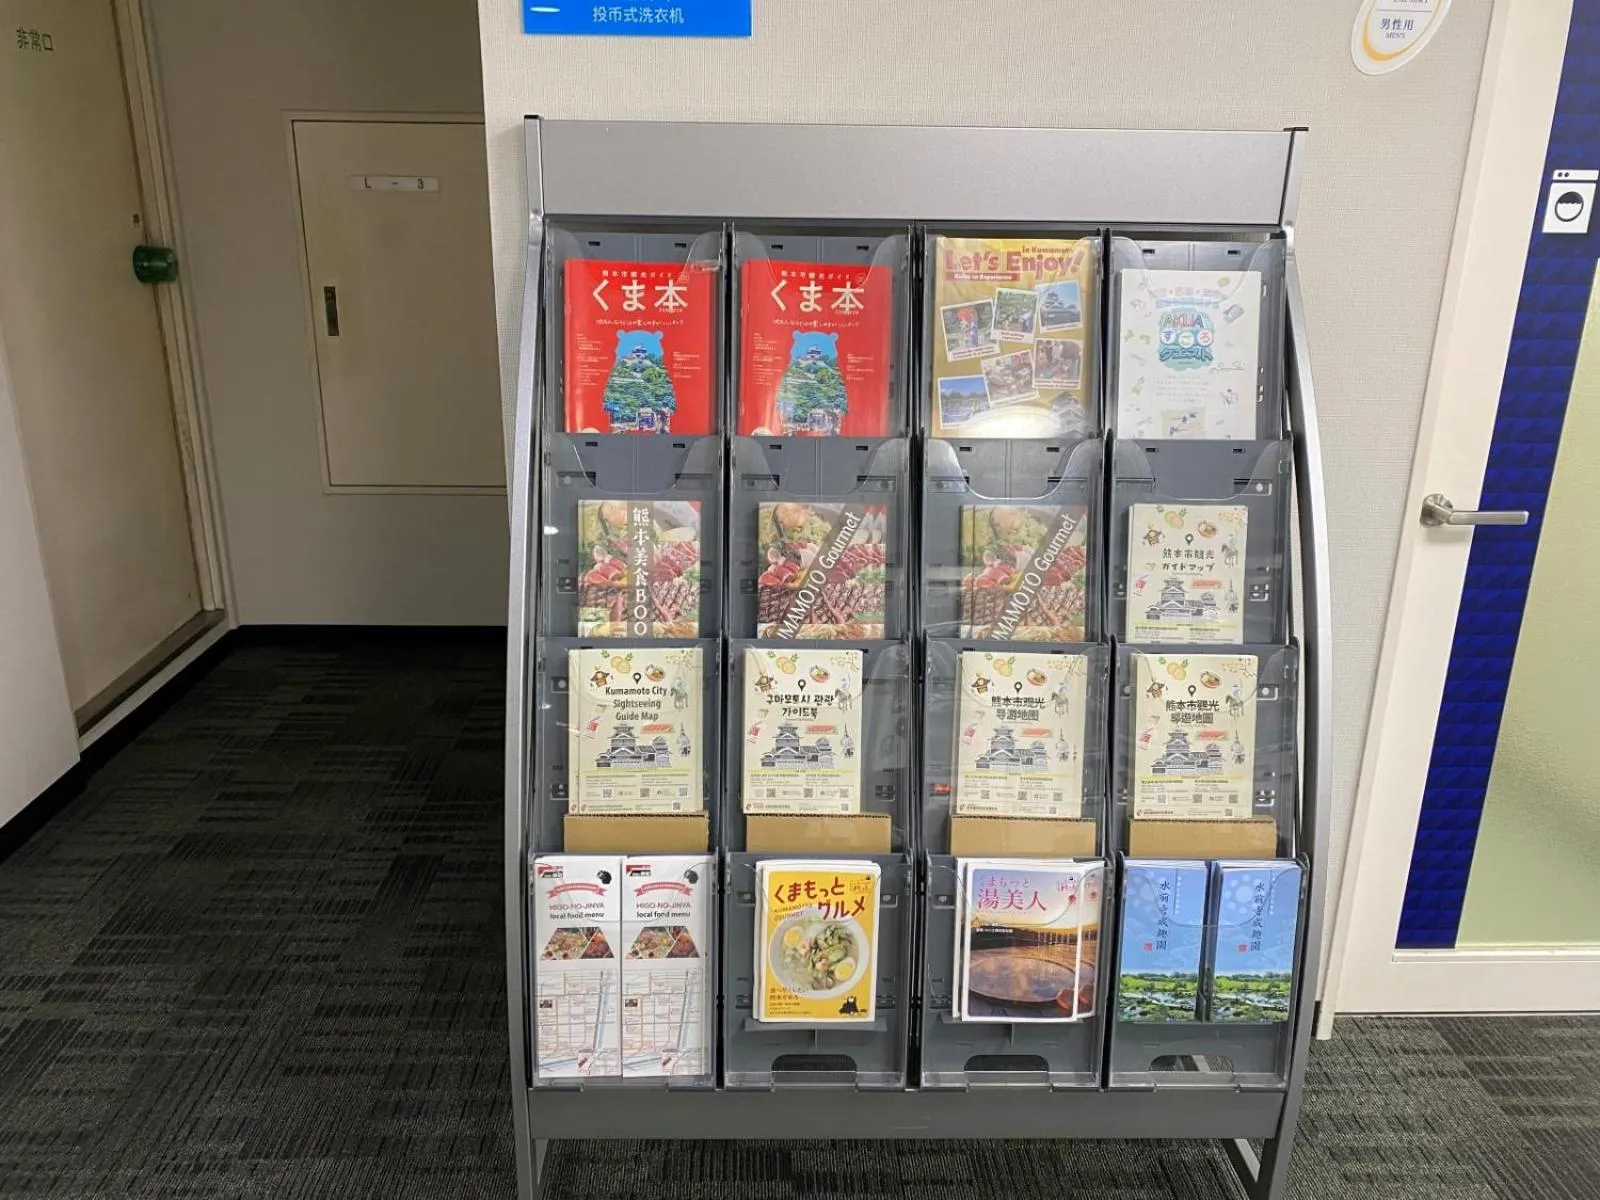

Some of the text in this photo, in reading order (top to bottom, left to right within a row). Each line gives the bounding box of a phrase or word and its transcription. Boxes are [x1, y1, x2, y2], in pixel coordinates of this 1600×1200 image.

[593, 7, 685, 25] 投币式洗衣机
[1380, 17, 1415, 31] 男性用
[16, 25, 54, 51] 非常口
[945, 248, 1085, 280] Let's Enjoy!
[592, 279, 689, 313] くま本
[771, 279, 865, 315] くま本
[818, 511, 861, 569] Gourmet
[1034, 513, 1077, 571] Gourmet
[1162, 562, 1216, 572] ガイドマップ
[605, 686, 667, 696] Kumamoto City
[766, 694, 834, 706] 구마모토시 관광
[613, 699, 661, 709] Sightseeing
[782, 707, 818, 719] 가이드북
[615, 711, 659, 722] Guide Map
[774, 876, 845, 904] くまもっと
[978, 888, 1047, 911] 湯美人
[636, 901, 691, 910] HIGO-NO-JINYA
[818, 895, 865, 921] グルメ
